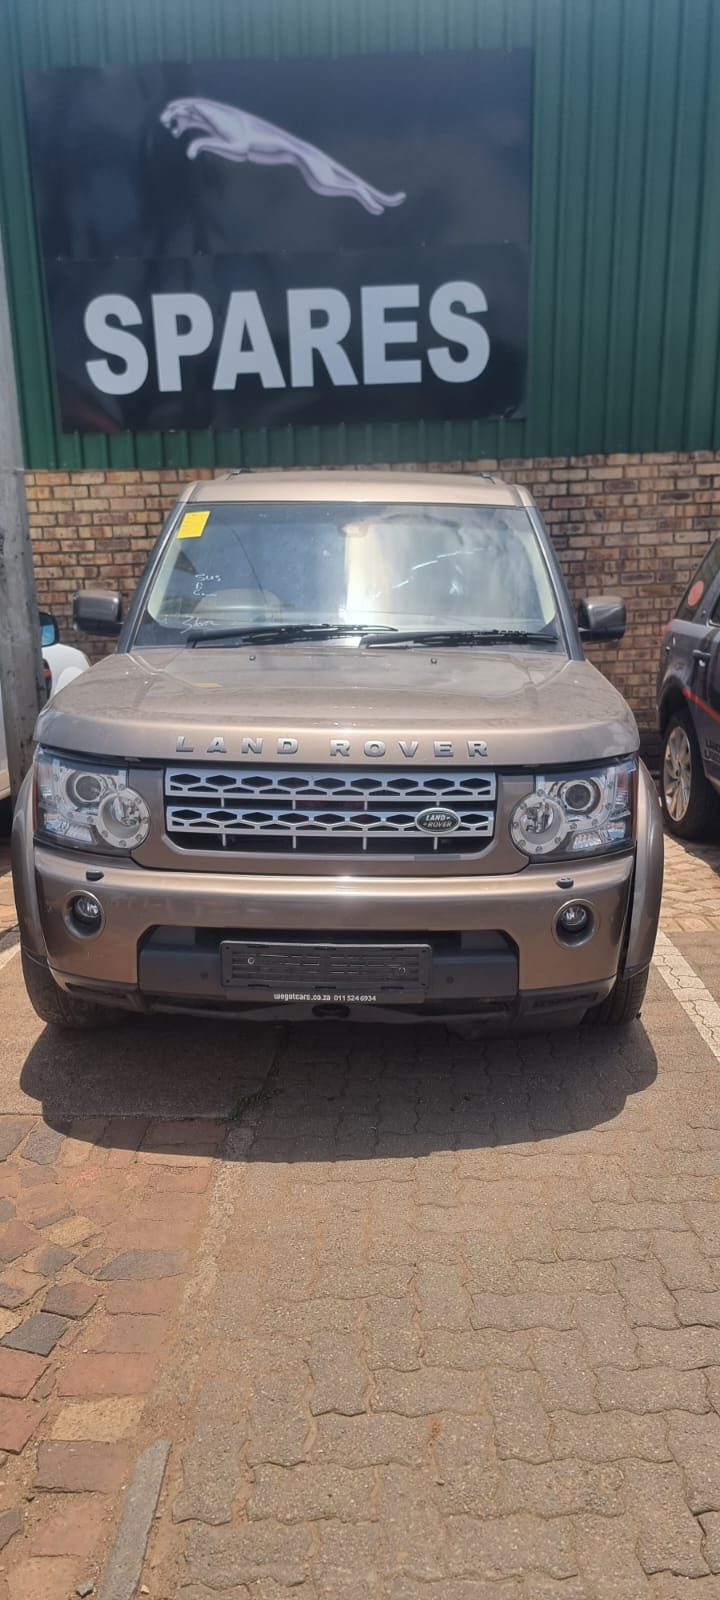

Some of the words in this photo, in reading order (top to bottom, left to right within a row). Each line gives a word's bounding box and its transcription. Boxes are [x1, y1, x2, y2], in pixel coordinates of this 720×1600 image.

[83, 281, 491, 395] SPARES
[175, 735, 299, 755] LAND
[329, 739, 488, 758] ROVER
[273, 992, 331, 1001] wegotcars.co.za
